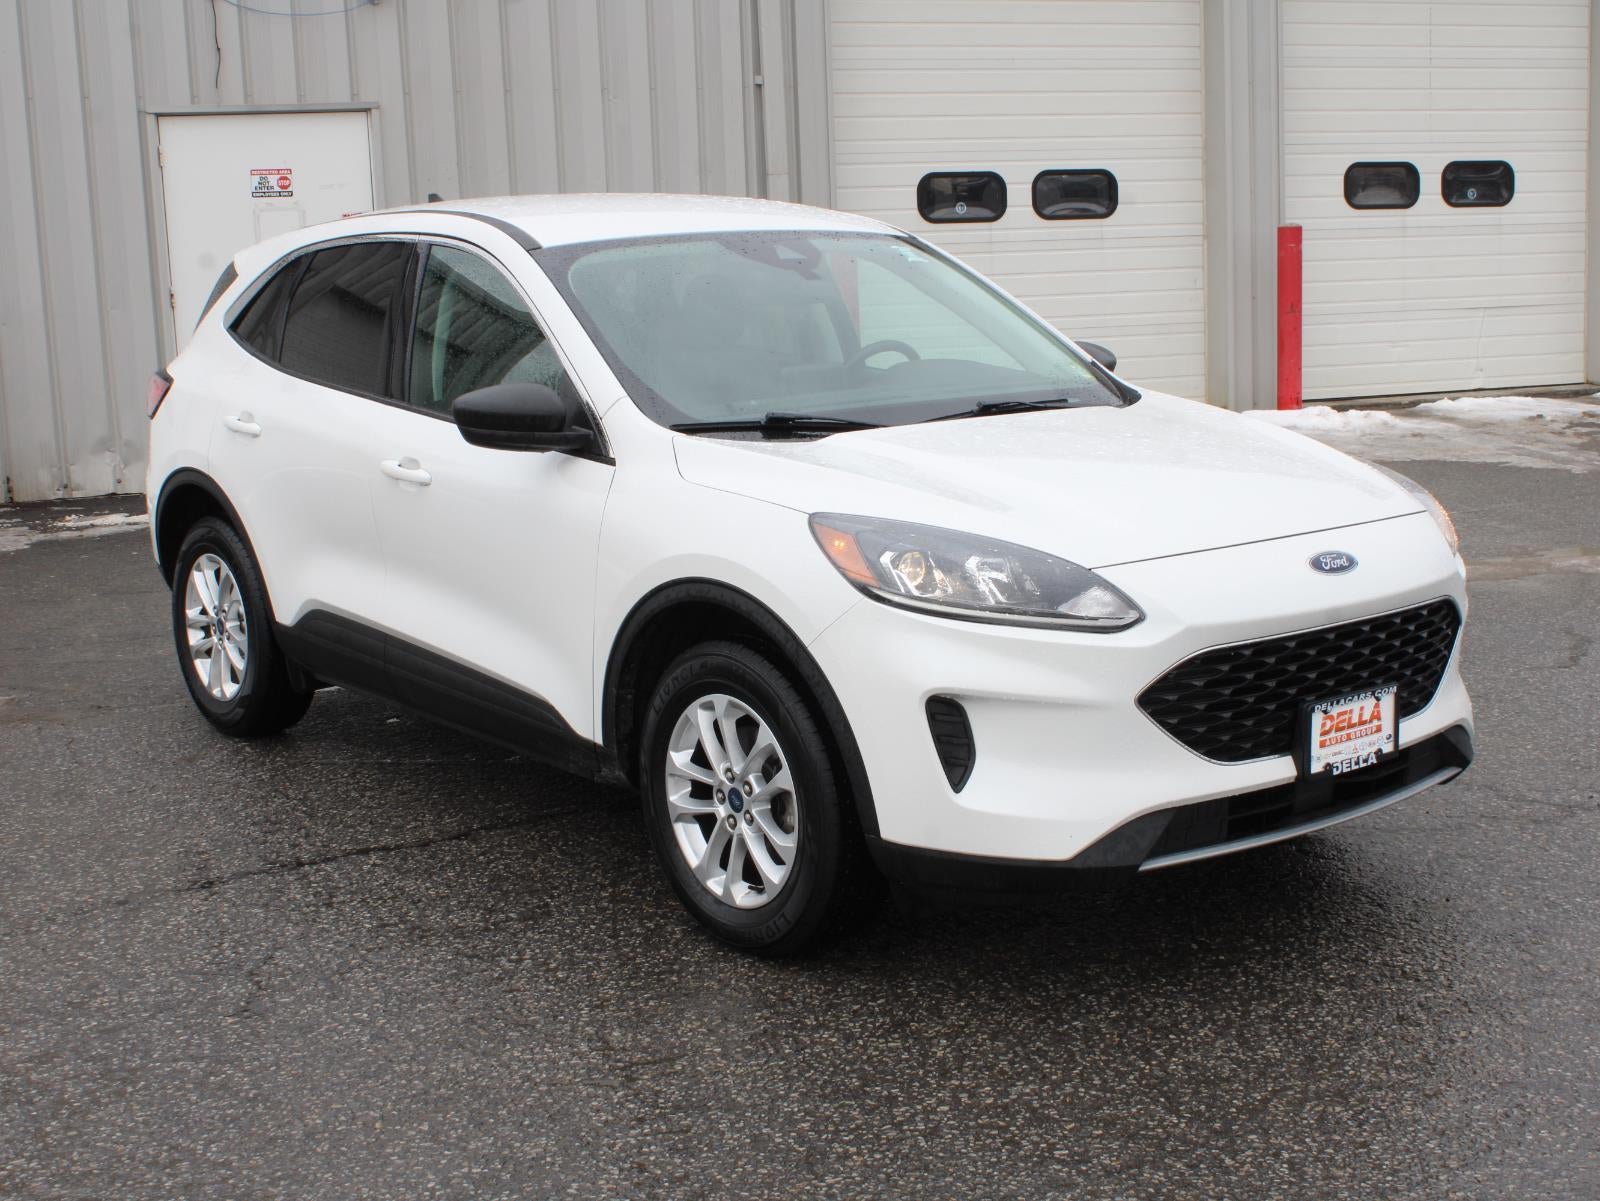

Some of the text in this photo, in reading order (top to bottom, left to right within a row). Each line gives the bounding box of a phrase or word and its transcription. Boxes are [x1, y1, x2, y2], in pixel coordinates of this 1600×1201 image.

[1320, 554, 1349, 570] Ford
[1319, 701, 1382, 737] DELLA
[1325, 725, 1377, 747] AUTO GROUP
[1332, 751, 1377, 776] DELLA
